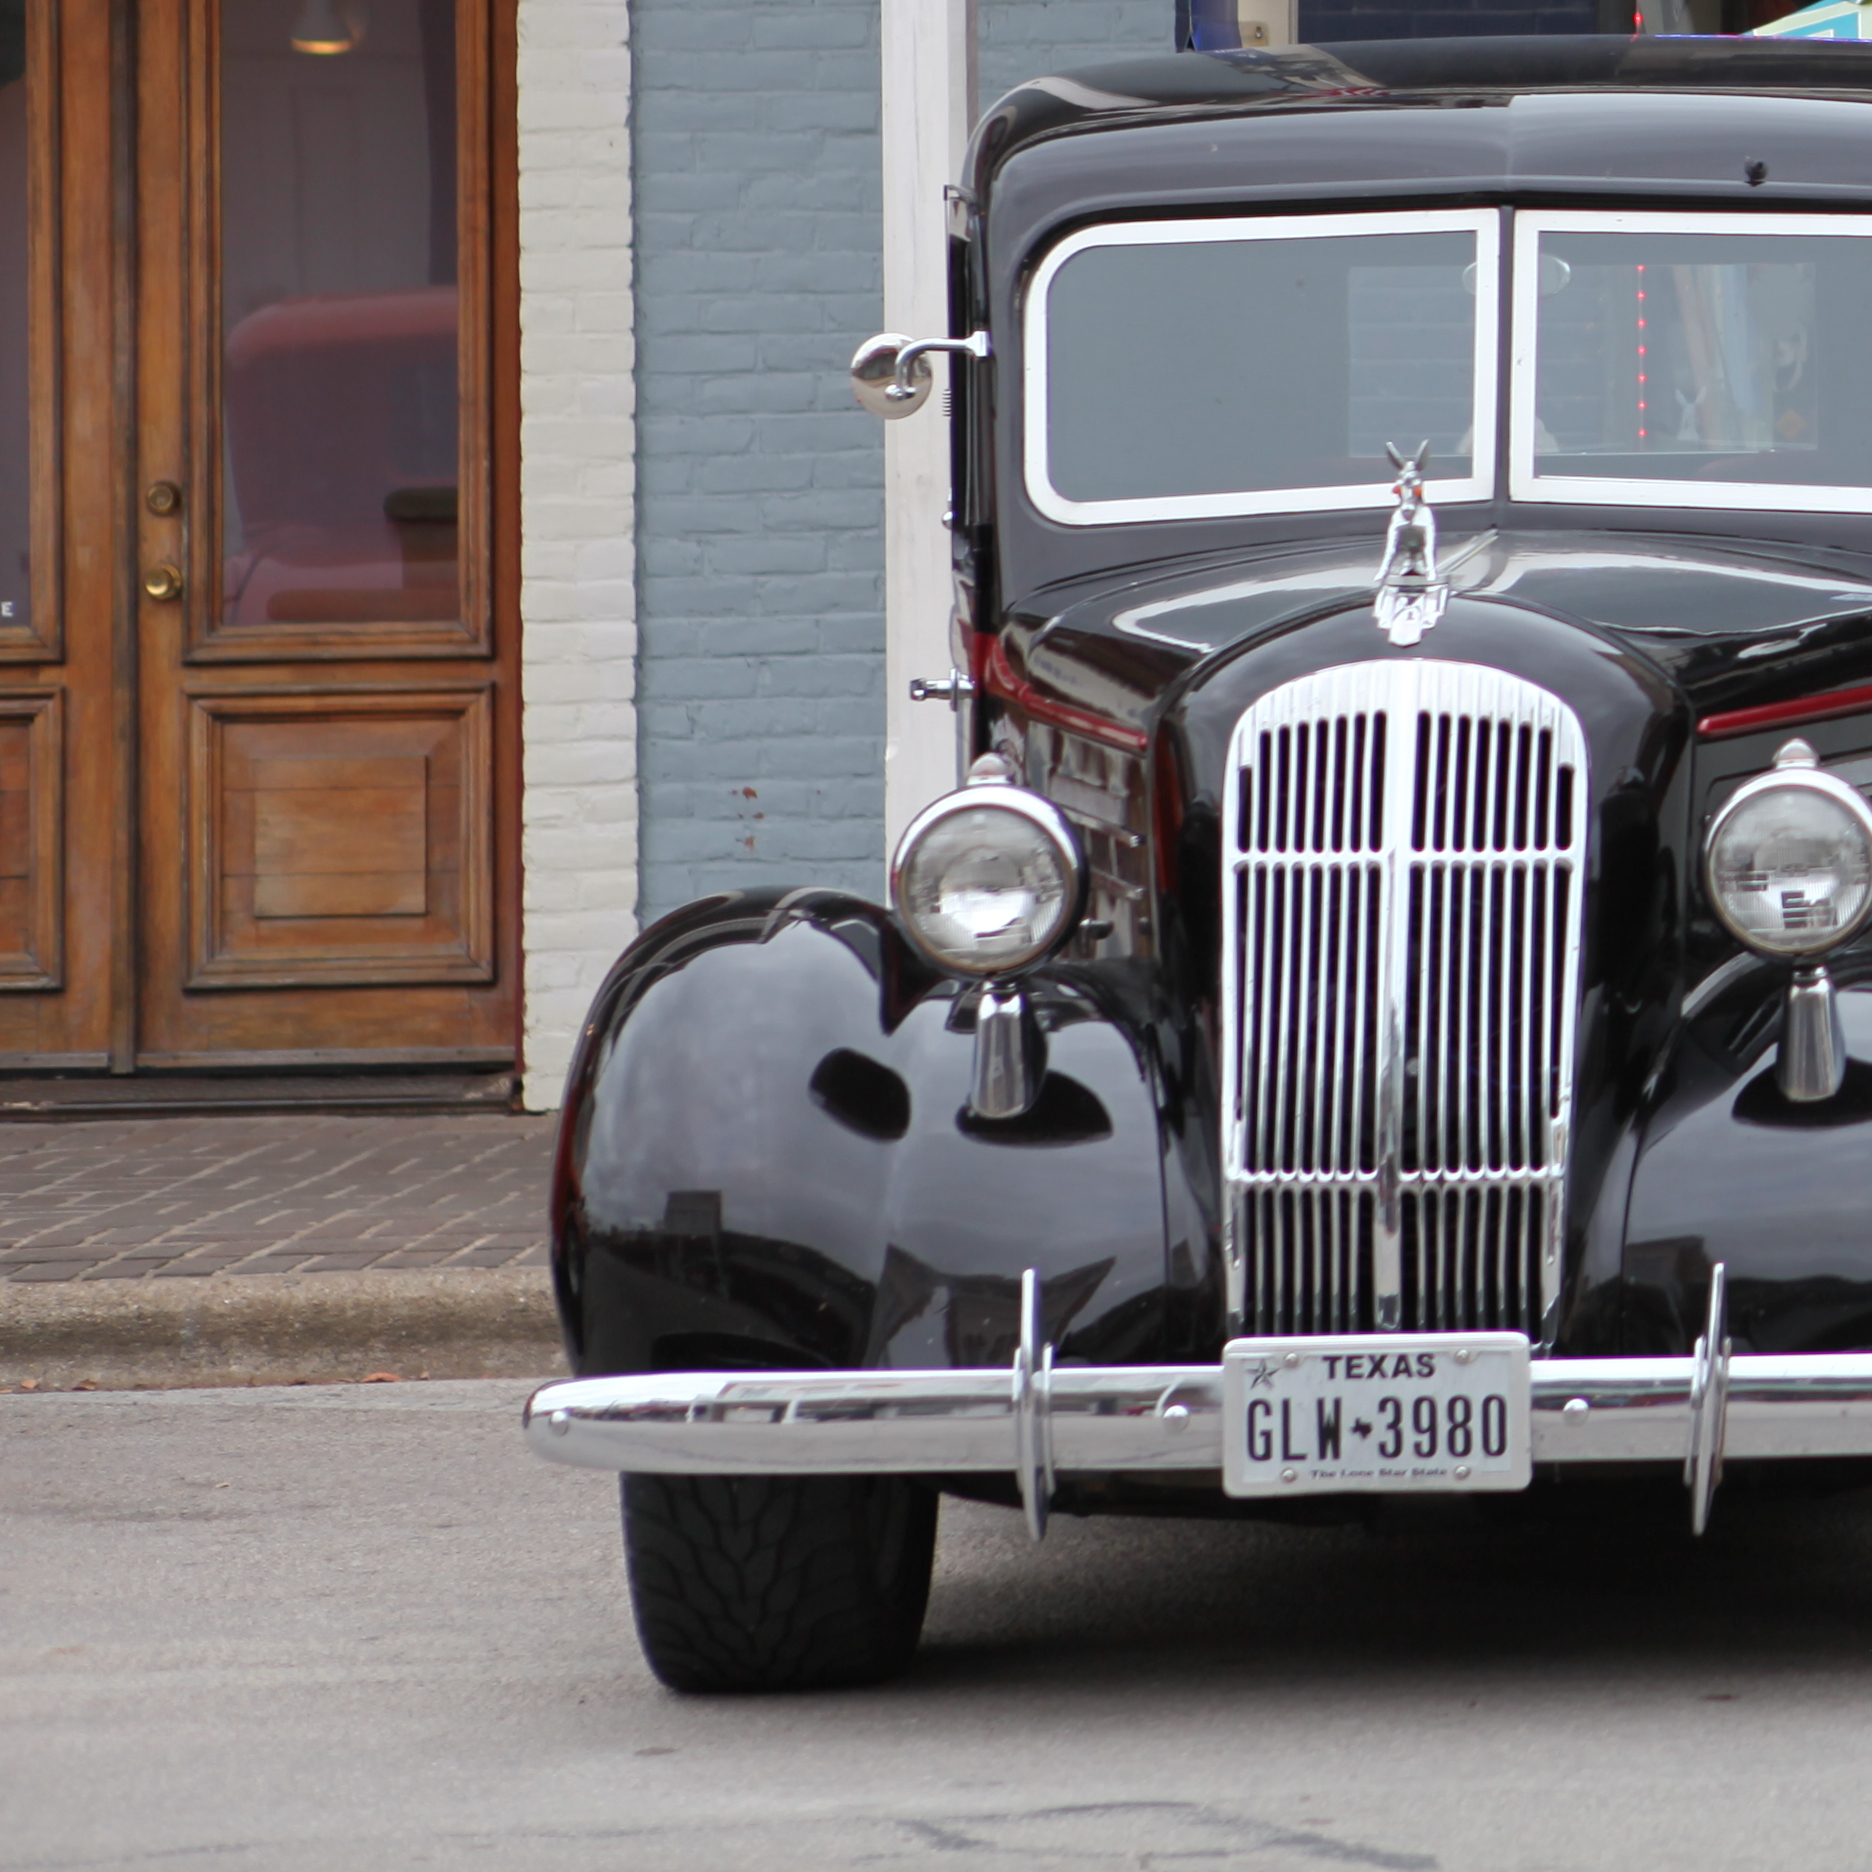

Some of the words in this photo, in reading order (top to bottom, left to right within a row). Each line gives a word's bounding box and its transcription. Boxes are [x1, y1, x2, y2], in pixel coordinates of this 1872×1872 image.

[1323, 1353, 1436, 1380] TEXAS
[1340, 1468, 1374, 1478] Lone
[1378, 1468, 1408, 1478] Star
[1411, 1467, 1447, 1478] State
